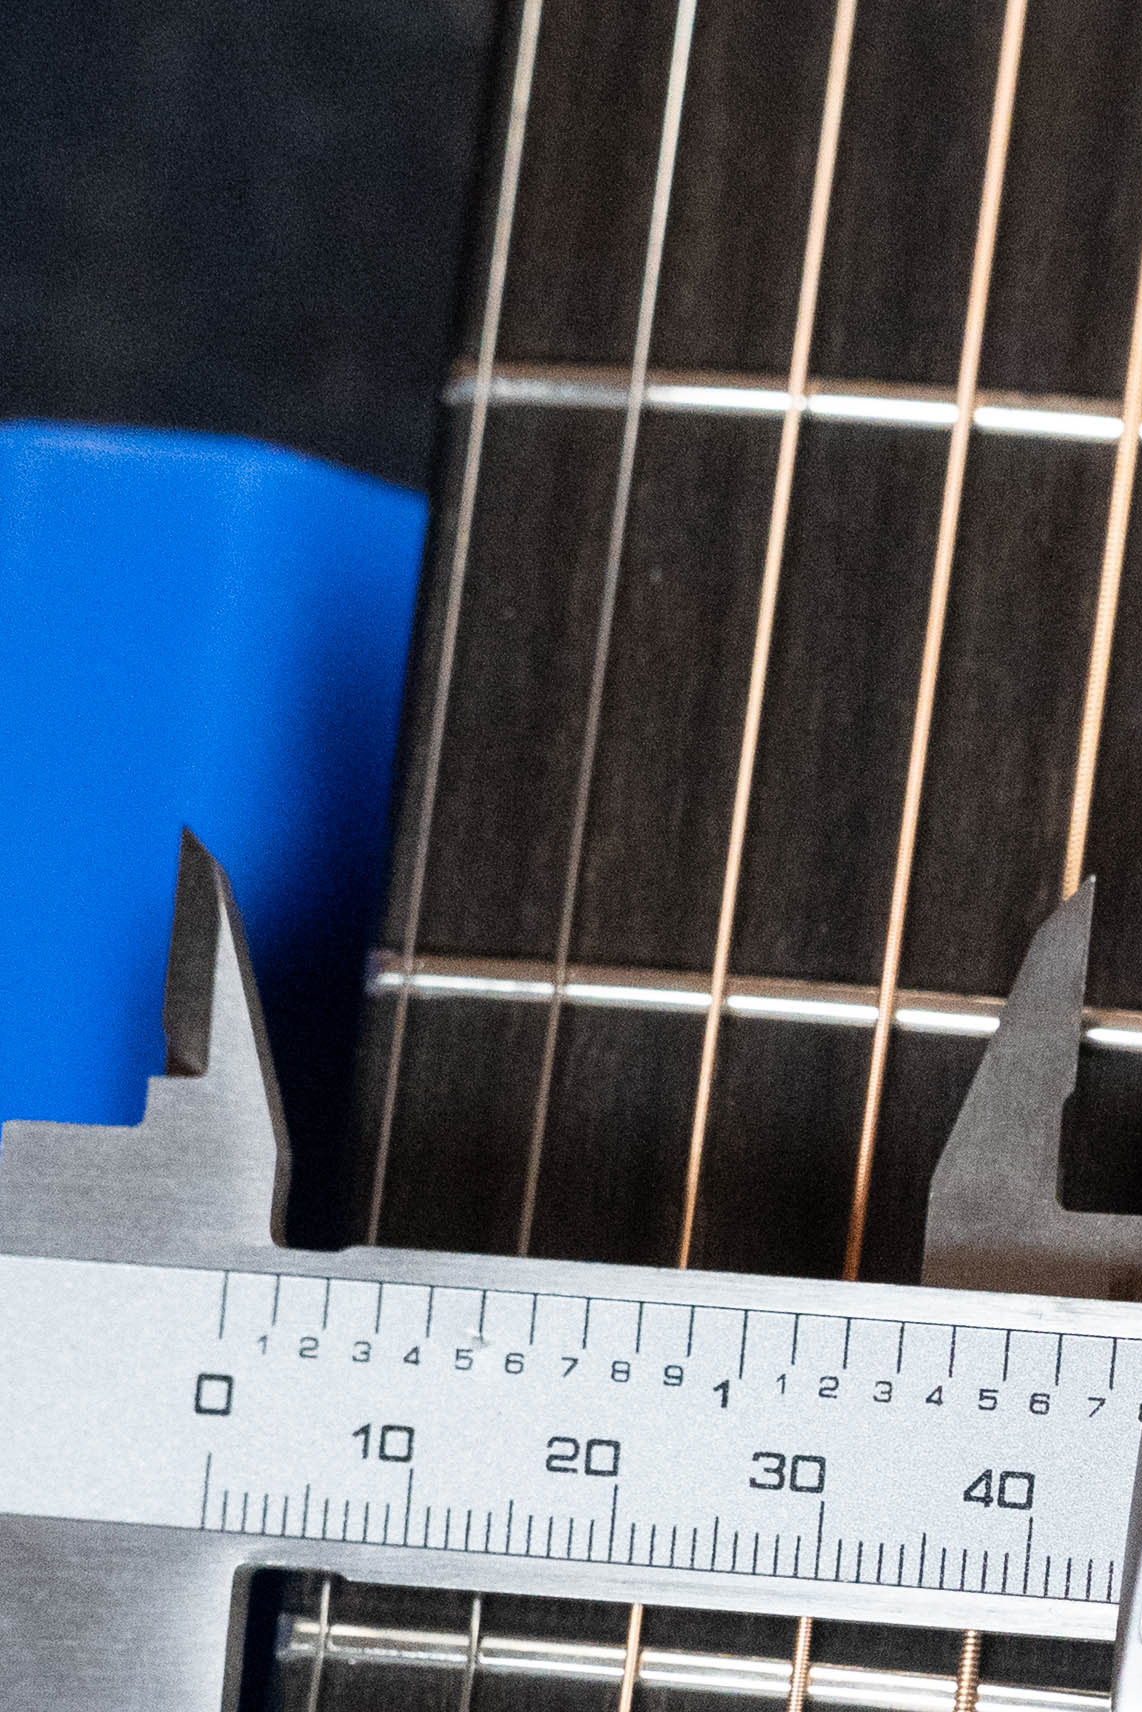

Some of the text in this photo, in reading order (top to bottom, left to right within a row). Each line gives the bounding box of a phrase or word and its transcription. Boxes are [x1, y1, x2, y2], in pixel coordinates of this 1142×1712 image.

[258, 1335, 1106, 1418] 1 2 3 4 5 6 7 8 9 1 1 2 3 4 5 6 7
[194, 1373, 1036, 1510] 0 10 20 30 40
